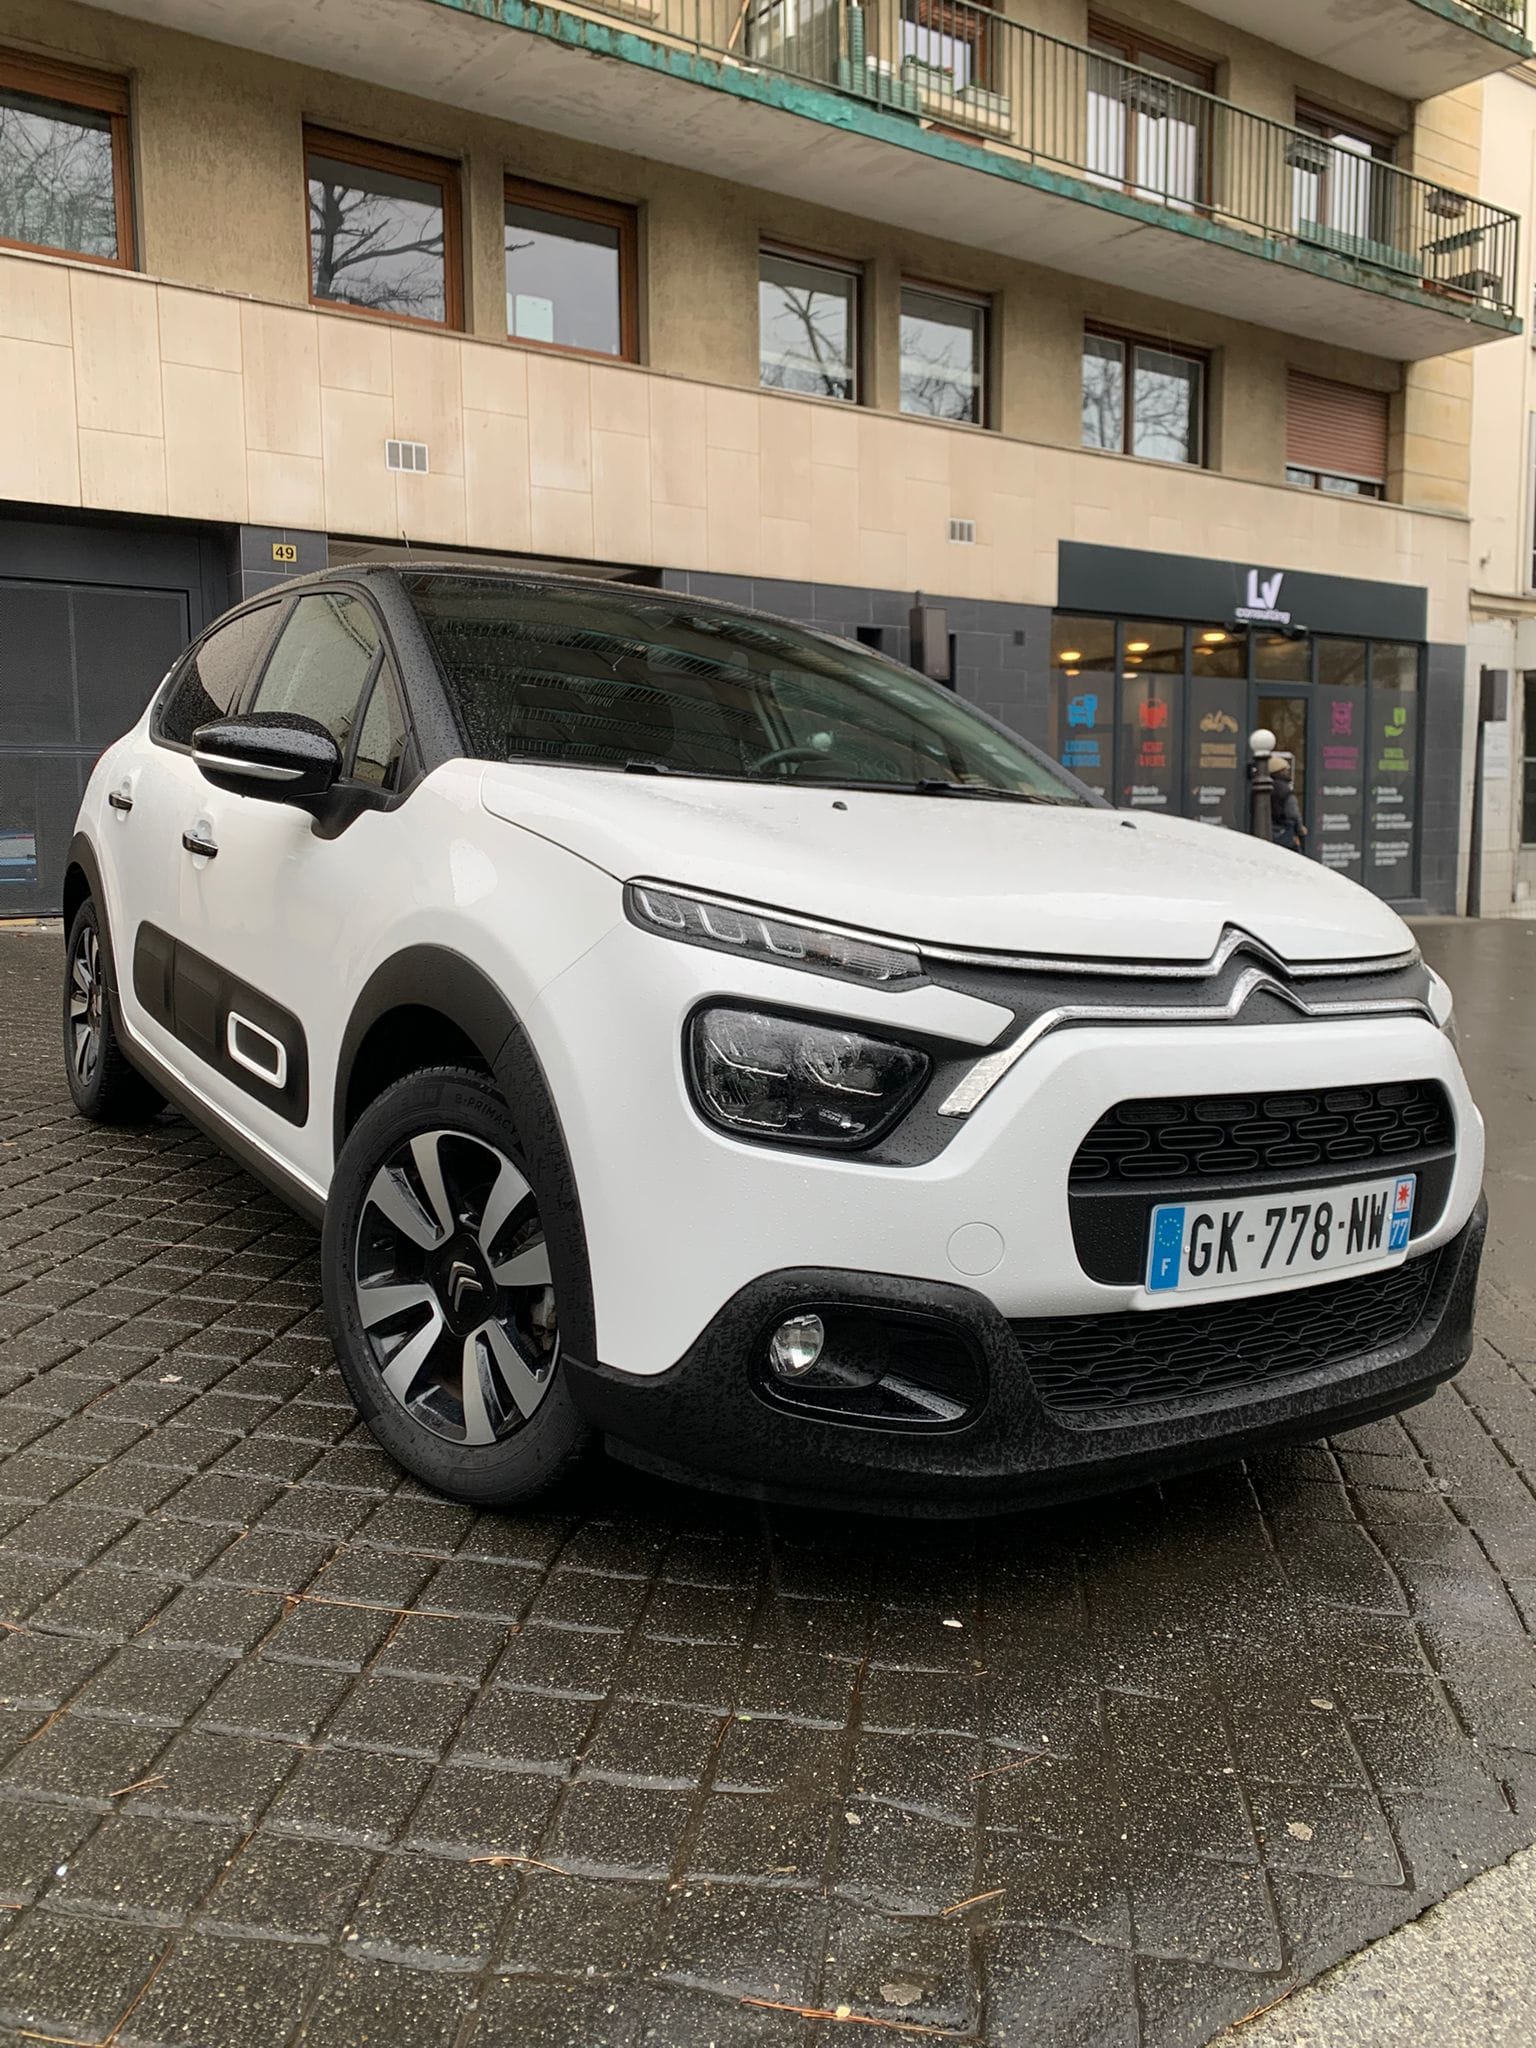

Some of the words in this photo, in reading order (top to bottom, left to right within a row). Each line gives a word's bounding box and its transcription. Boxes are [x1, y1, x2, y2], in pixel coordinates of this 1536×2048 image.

[275, 546, 294, 559] 49
[1187, 1191, 1388, 1277] GK-778-NW
[1391, 1217, 1409, 1246] 77
[1160, 1257, 1172, 1277] F
